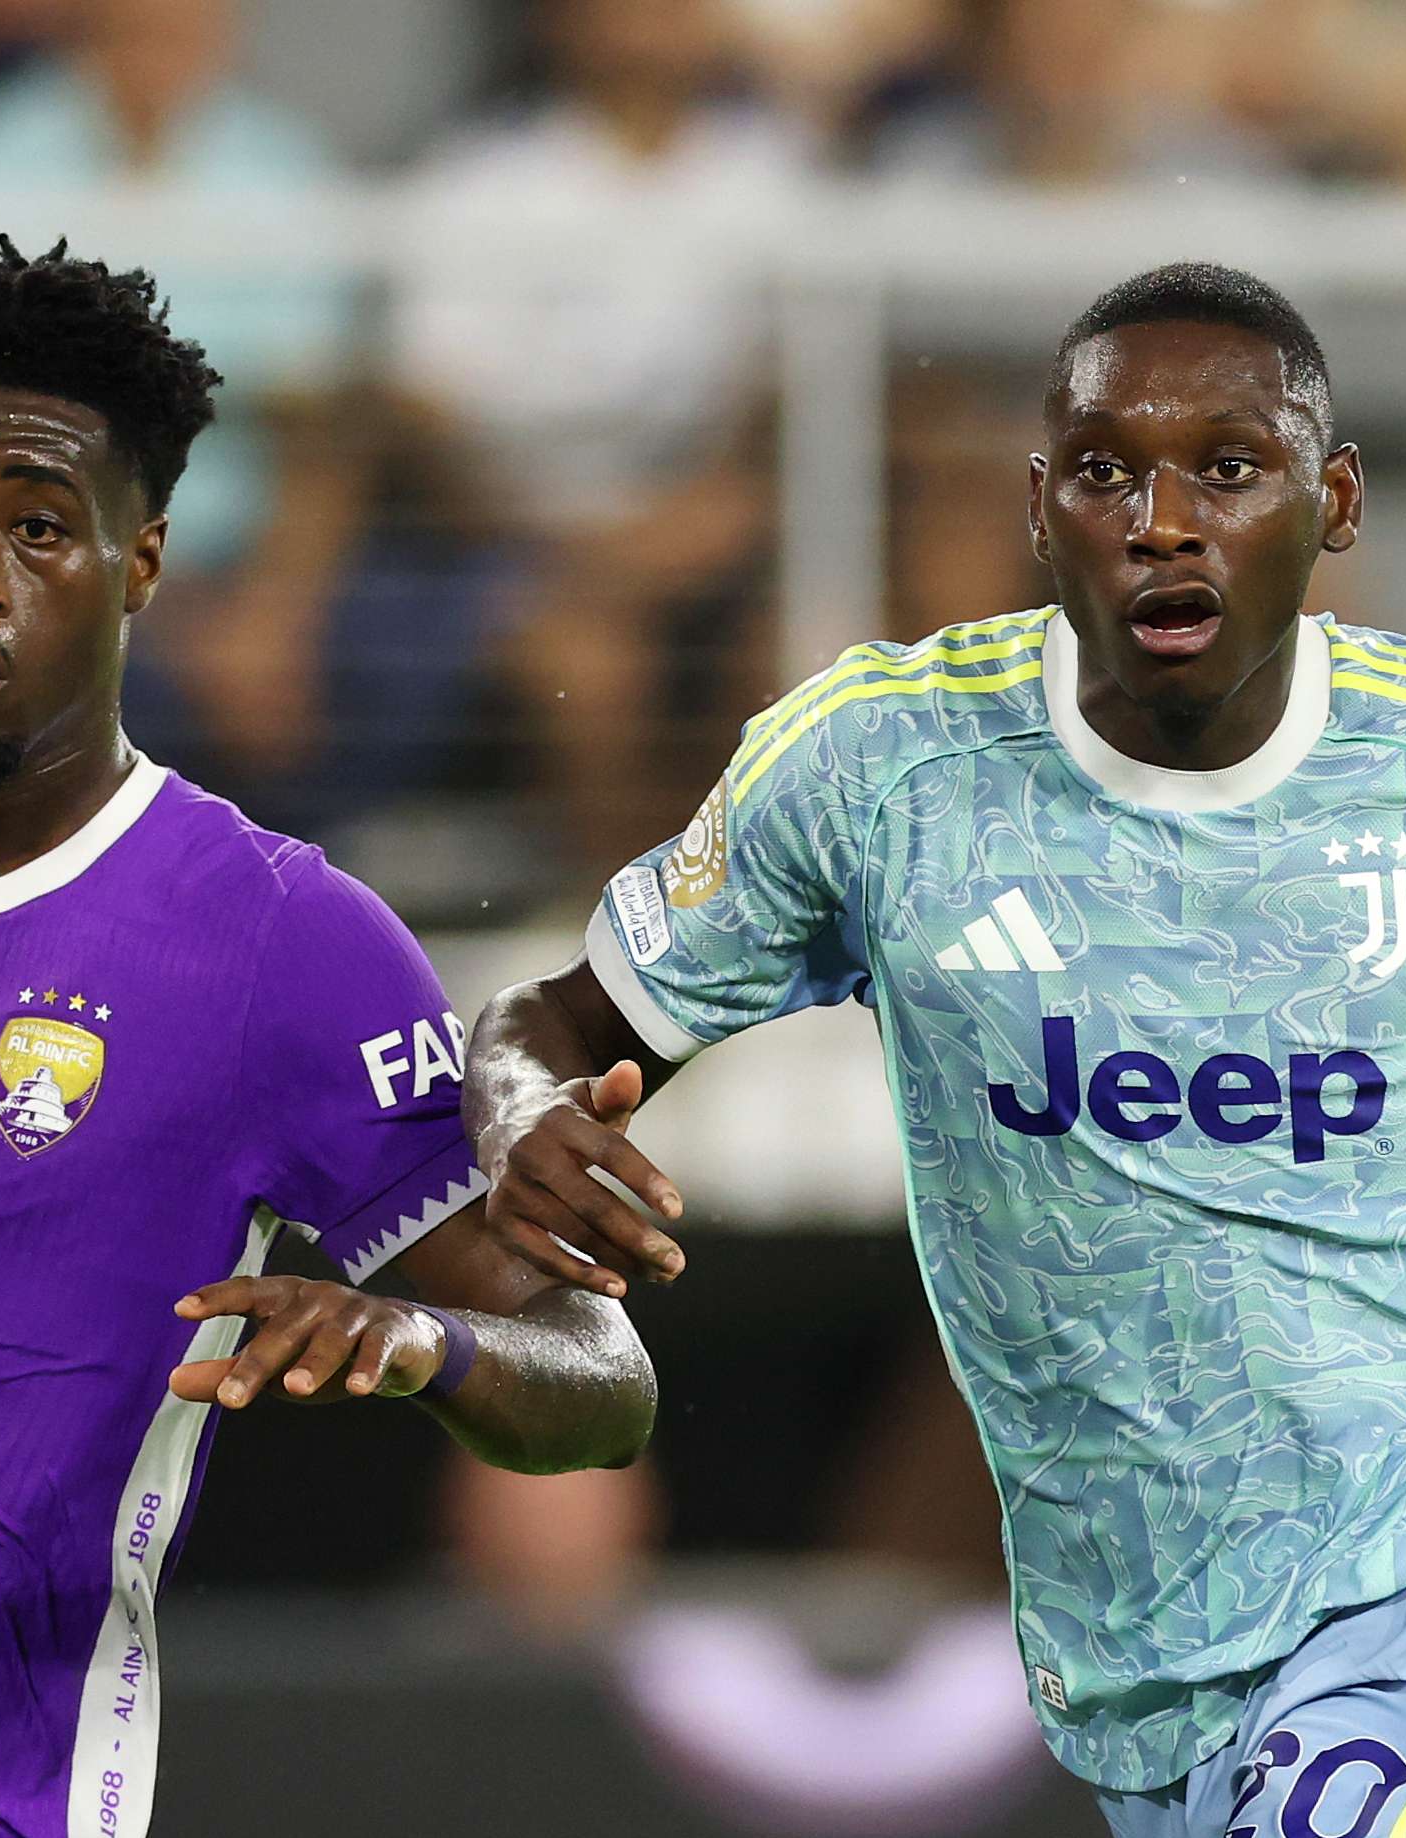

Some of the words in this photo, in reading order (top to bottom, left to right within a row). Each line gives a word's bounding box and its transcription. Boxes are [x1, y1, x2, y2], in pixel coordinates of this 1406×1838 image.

[714, 807, 724, 843] CUP
[689, 872, 713, 893] USA
[620, 888, 646, 925] World
[7, 1035, 30, 1053] AL
[32, 1040, 65, 1064] AIN
[64, 1049, 92, 1068] FC
[987, 1016, 1388, 1164] Jeep
[128, 1492, 161, 1564] 1968
[120, 1646, 143, 1688] AIN
[113, 1694, 135, 1723] AL
